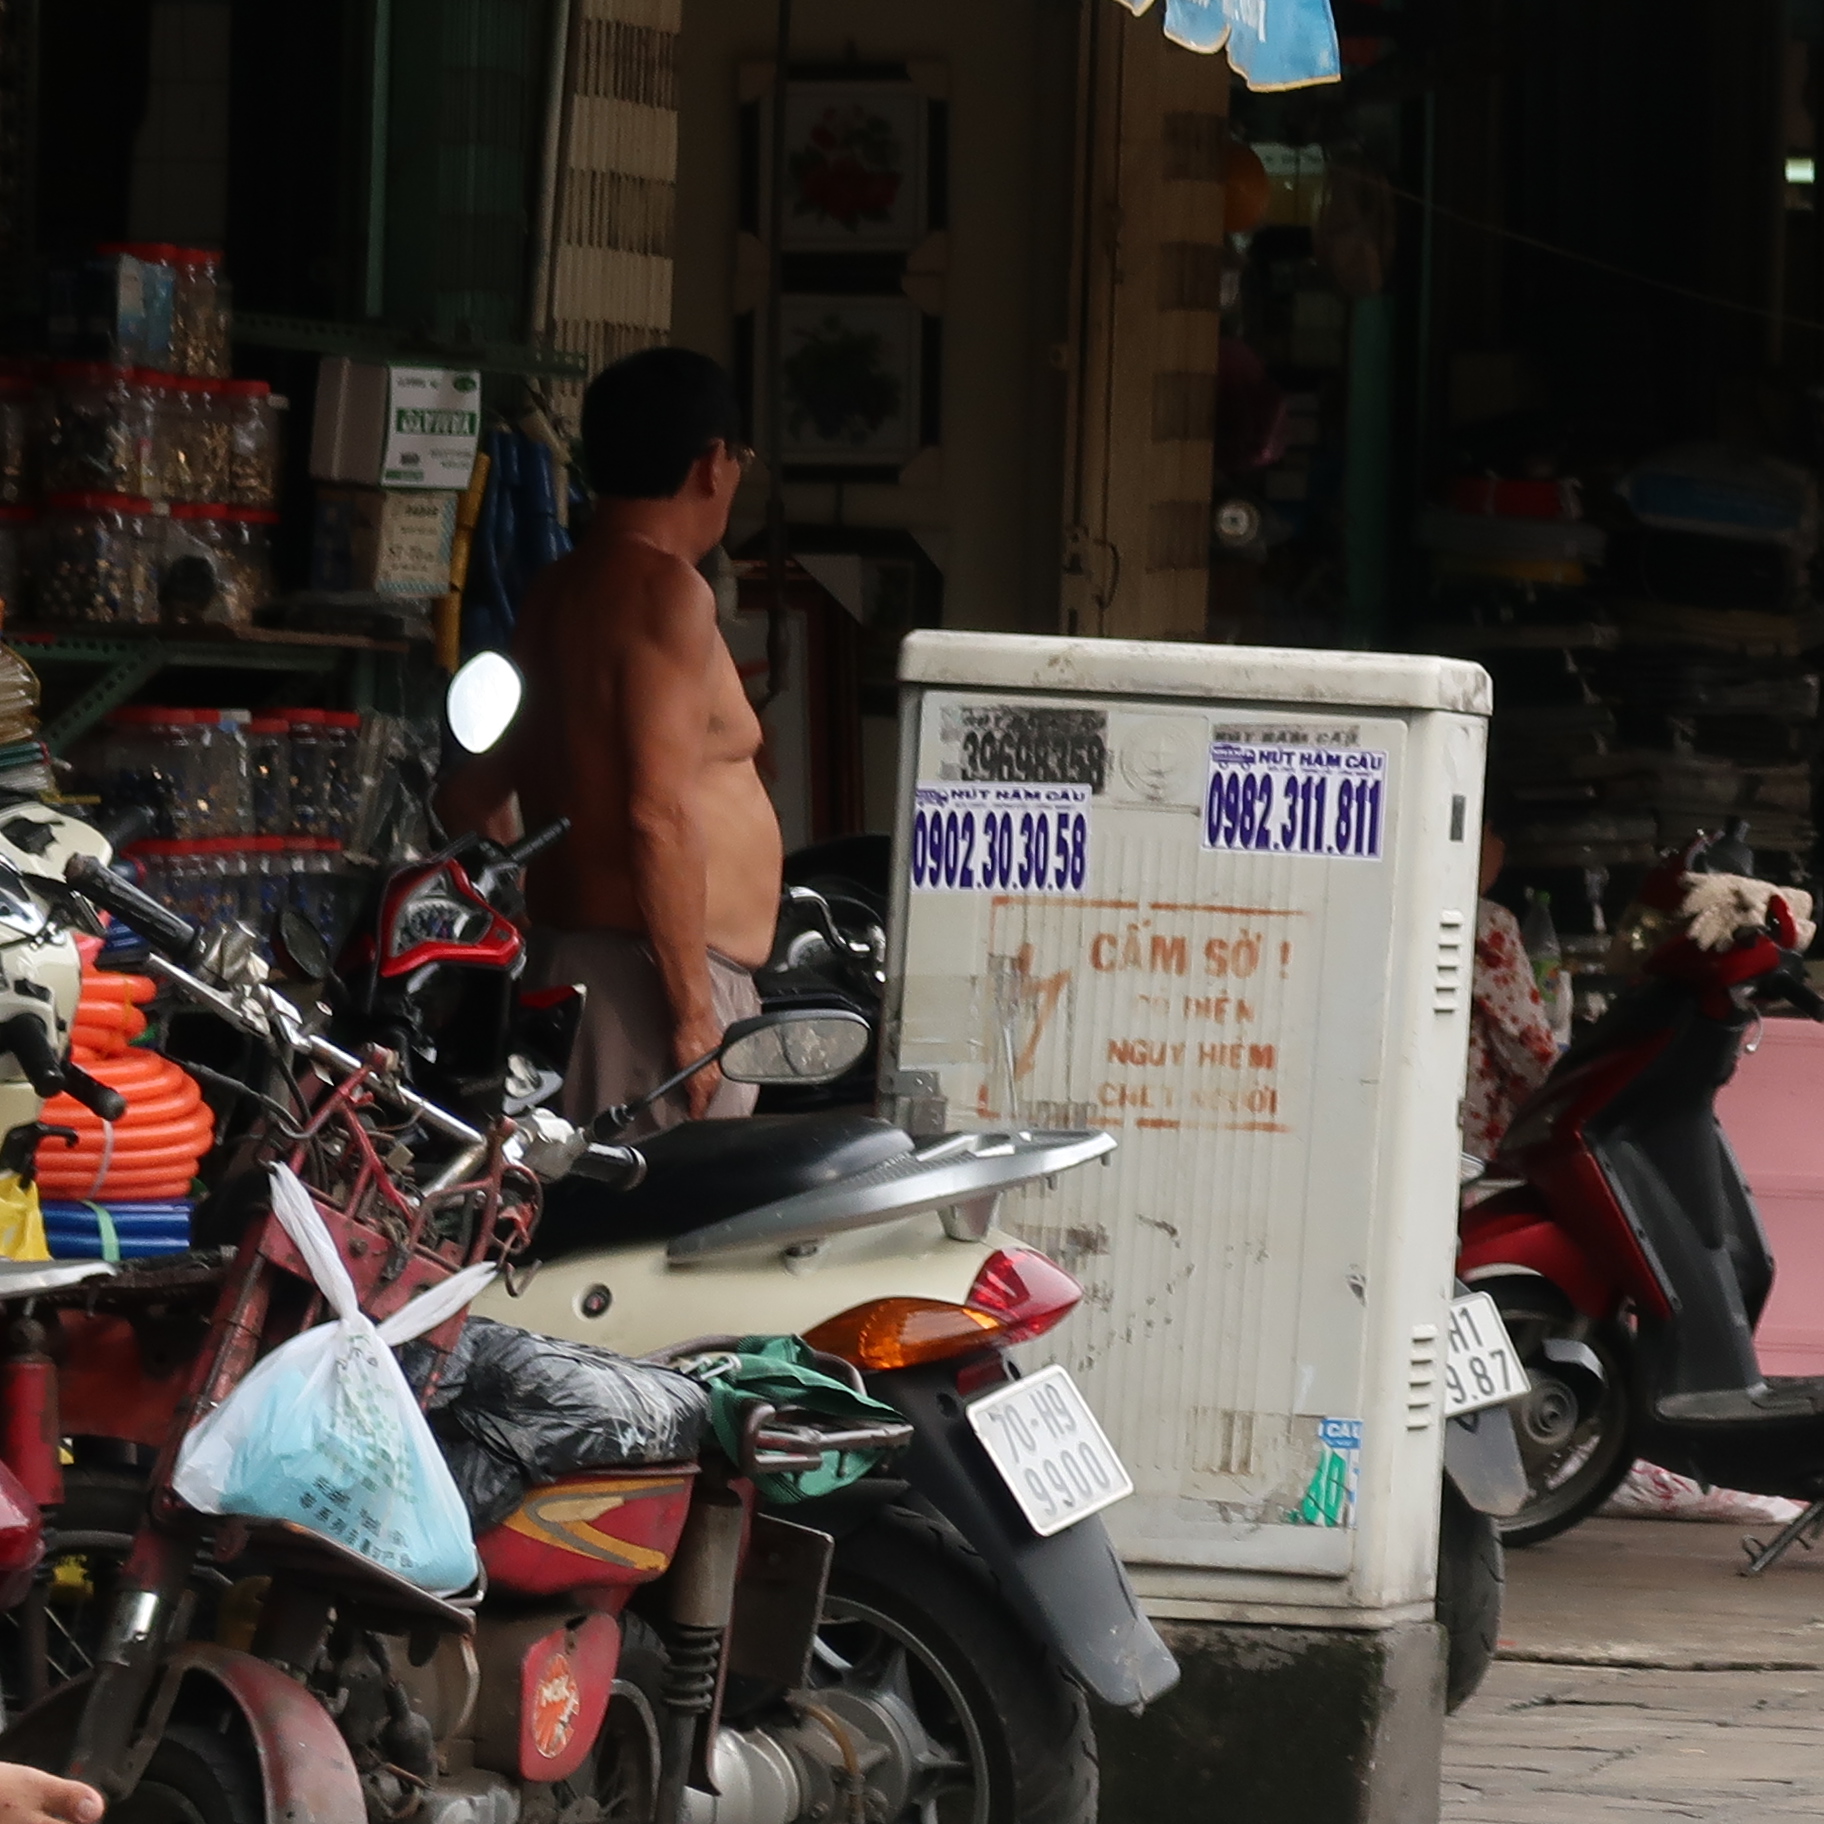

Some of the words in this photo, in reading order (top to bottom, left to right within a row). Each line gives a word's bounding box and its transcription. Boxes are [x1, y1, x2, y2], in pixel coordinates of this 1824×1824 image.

[913, 810, 1087, 890] 0902.30.30.58
[1208, 771, 1382, 856] 0982.311.811
[1089, 919, 1189, 977] CẤM
[1107, 1037, 1186, 1067] NGUY
[986, 1382, 1077, 1464] 70-H9
[1022, 1440, 1111, 1516] 9900
